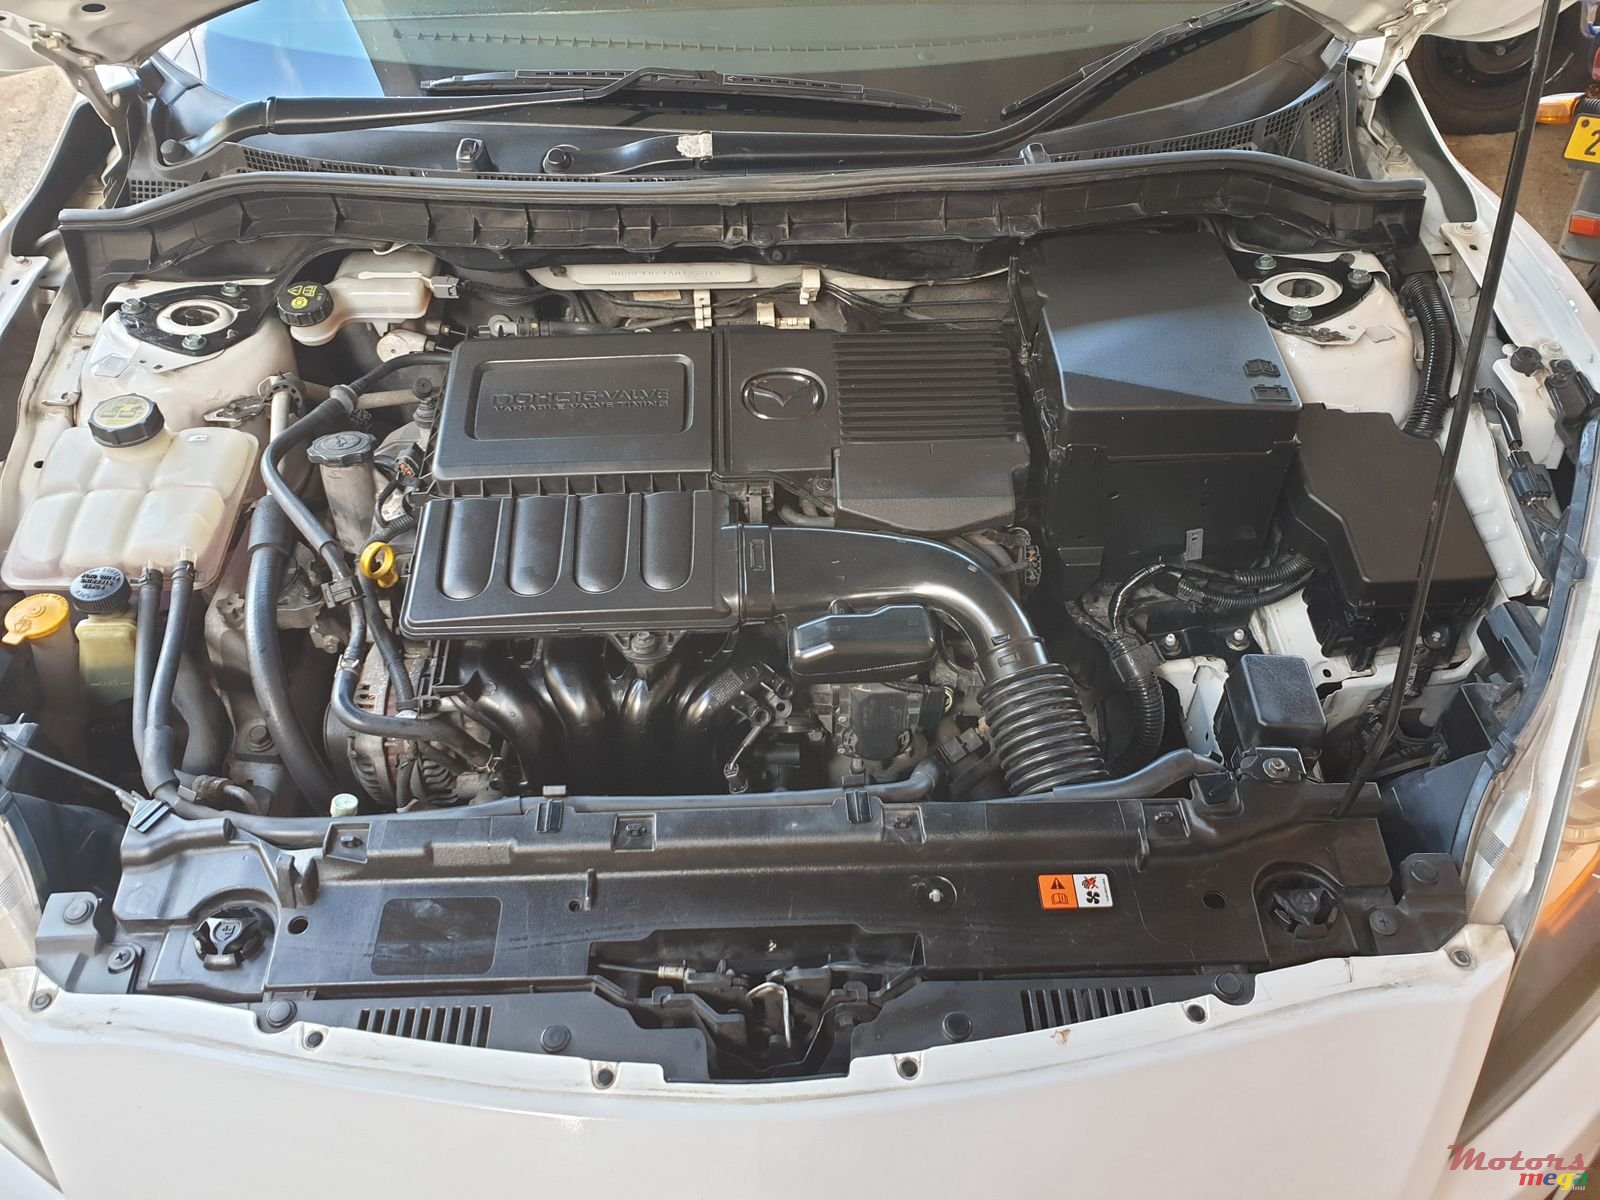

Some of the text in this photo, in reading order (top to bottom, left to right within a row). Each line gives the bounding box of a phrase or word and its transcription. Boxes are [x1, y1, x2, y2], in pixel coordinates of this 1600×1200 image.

[1584, 129, 1600, 156] 2
[493, 388, 669, 405] DOHC 16-VALVE
